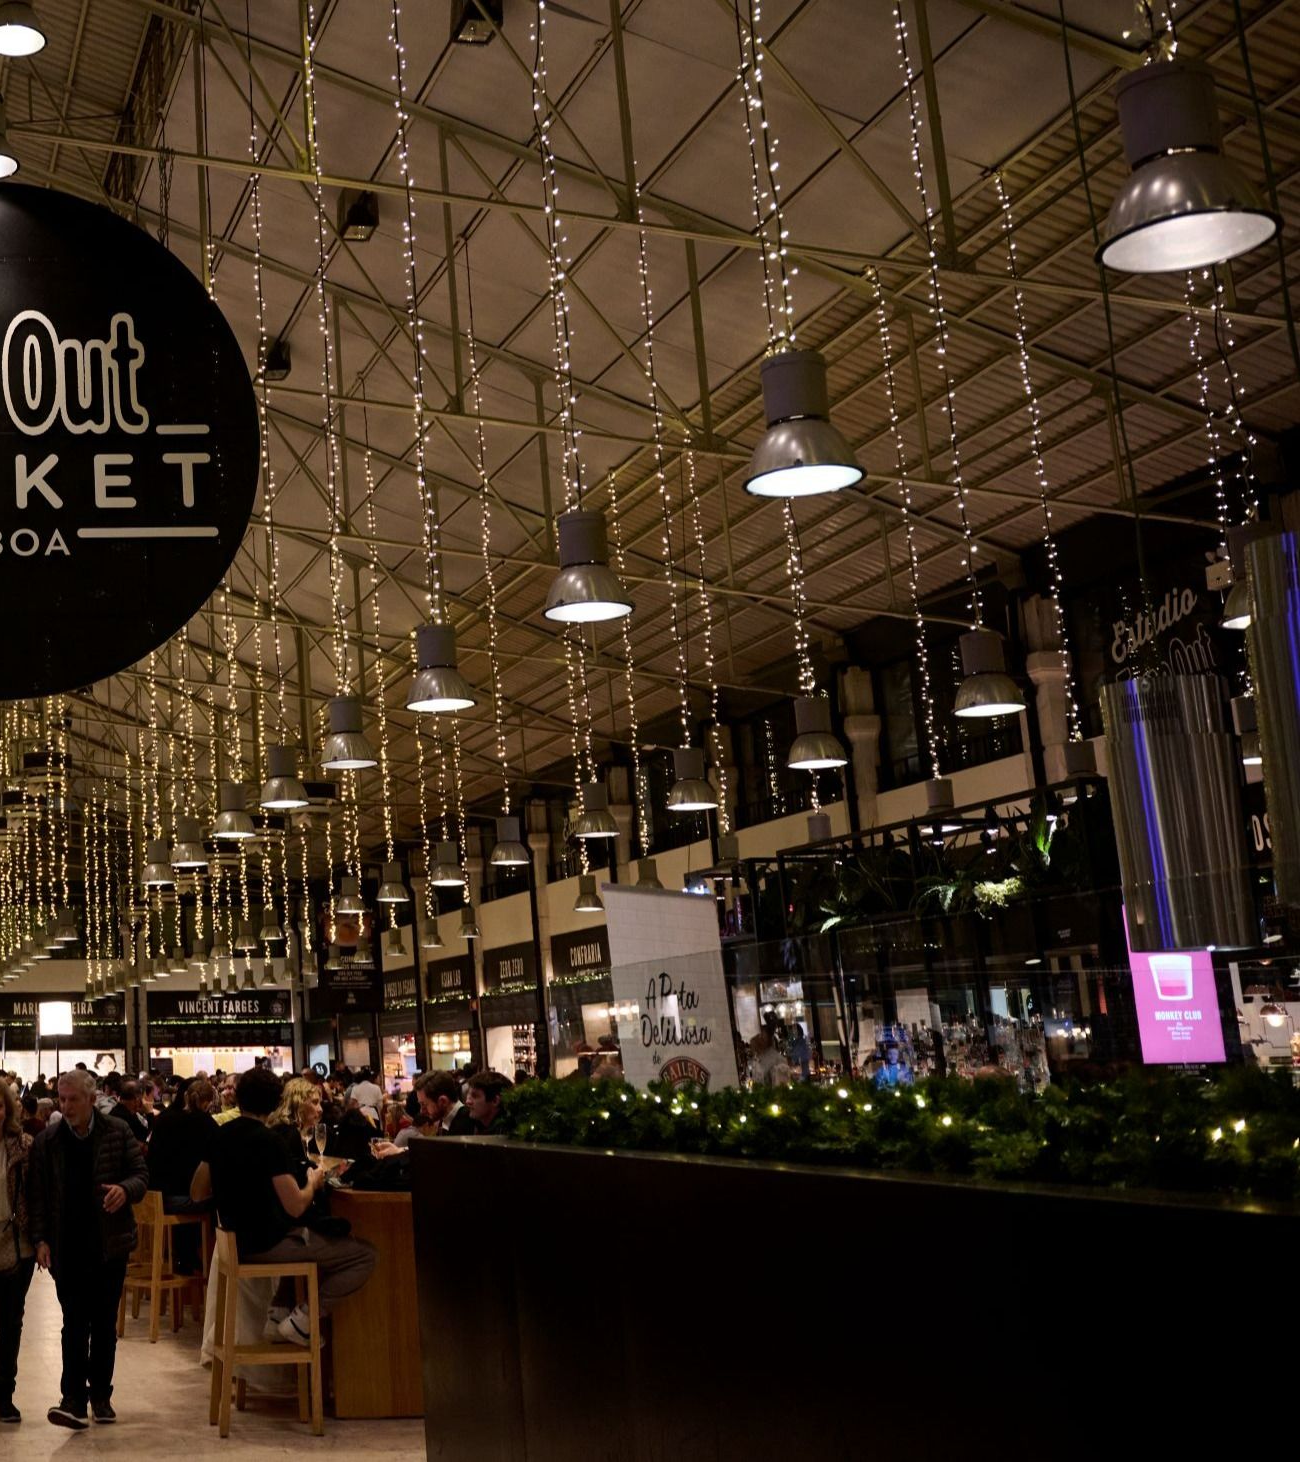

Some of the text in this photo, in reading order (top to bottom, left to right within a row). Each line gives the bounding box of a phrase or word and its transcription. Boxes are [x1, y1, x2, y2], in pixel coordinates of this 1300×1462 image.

[2, 309, 150, 436] Out
[570, 942, 602, 968] CONFRARIA
[500, 957, 524, 979] ZERO ZERO
[645, 978, 657, 1010] A
[178, 1000, 260, 1014] VINCENT FARGES
[1155, 1010, 1202, 1021] MONKEY CLUB
